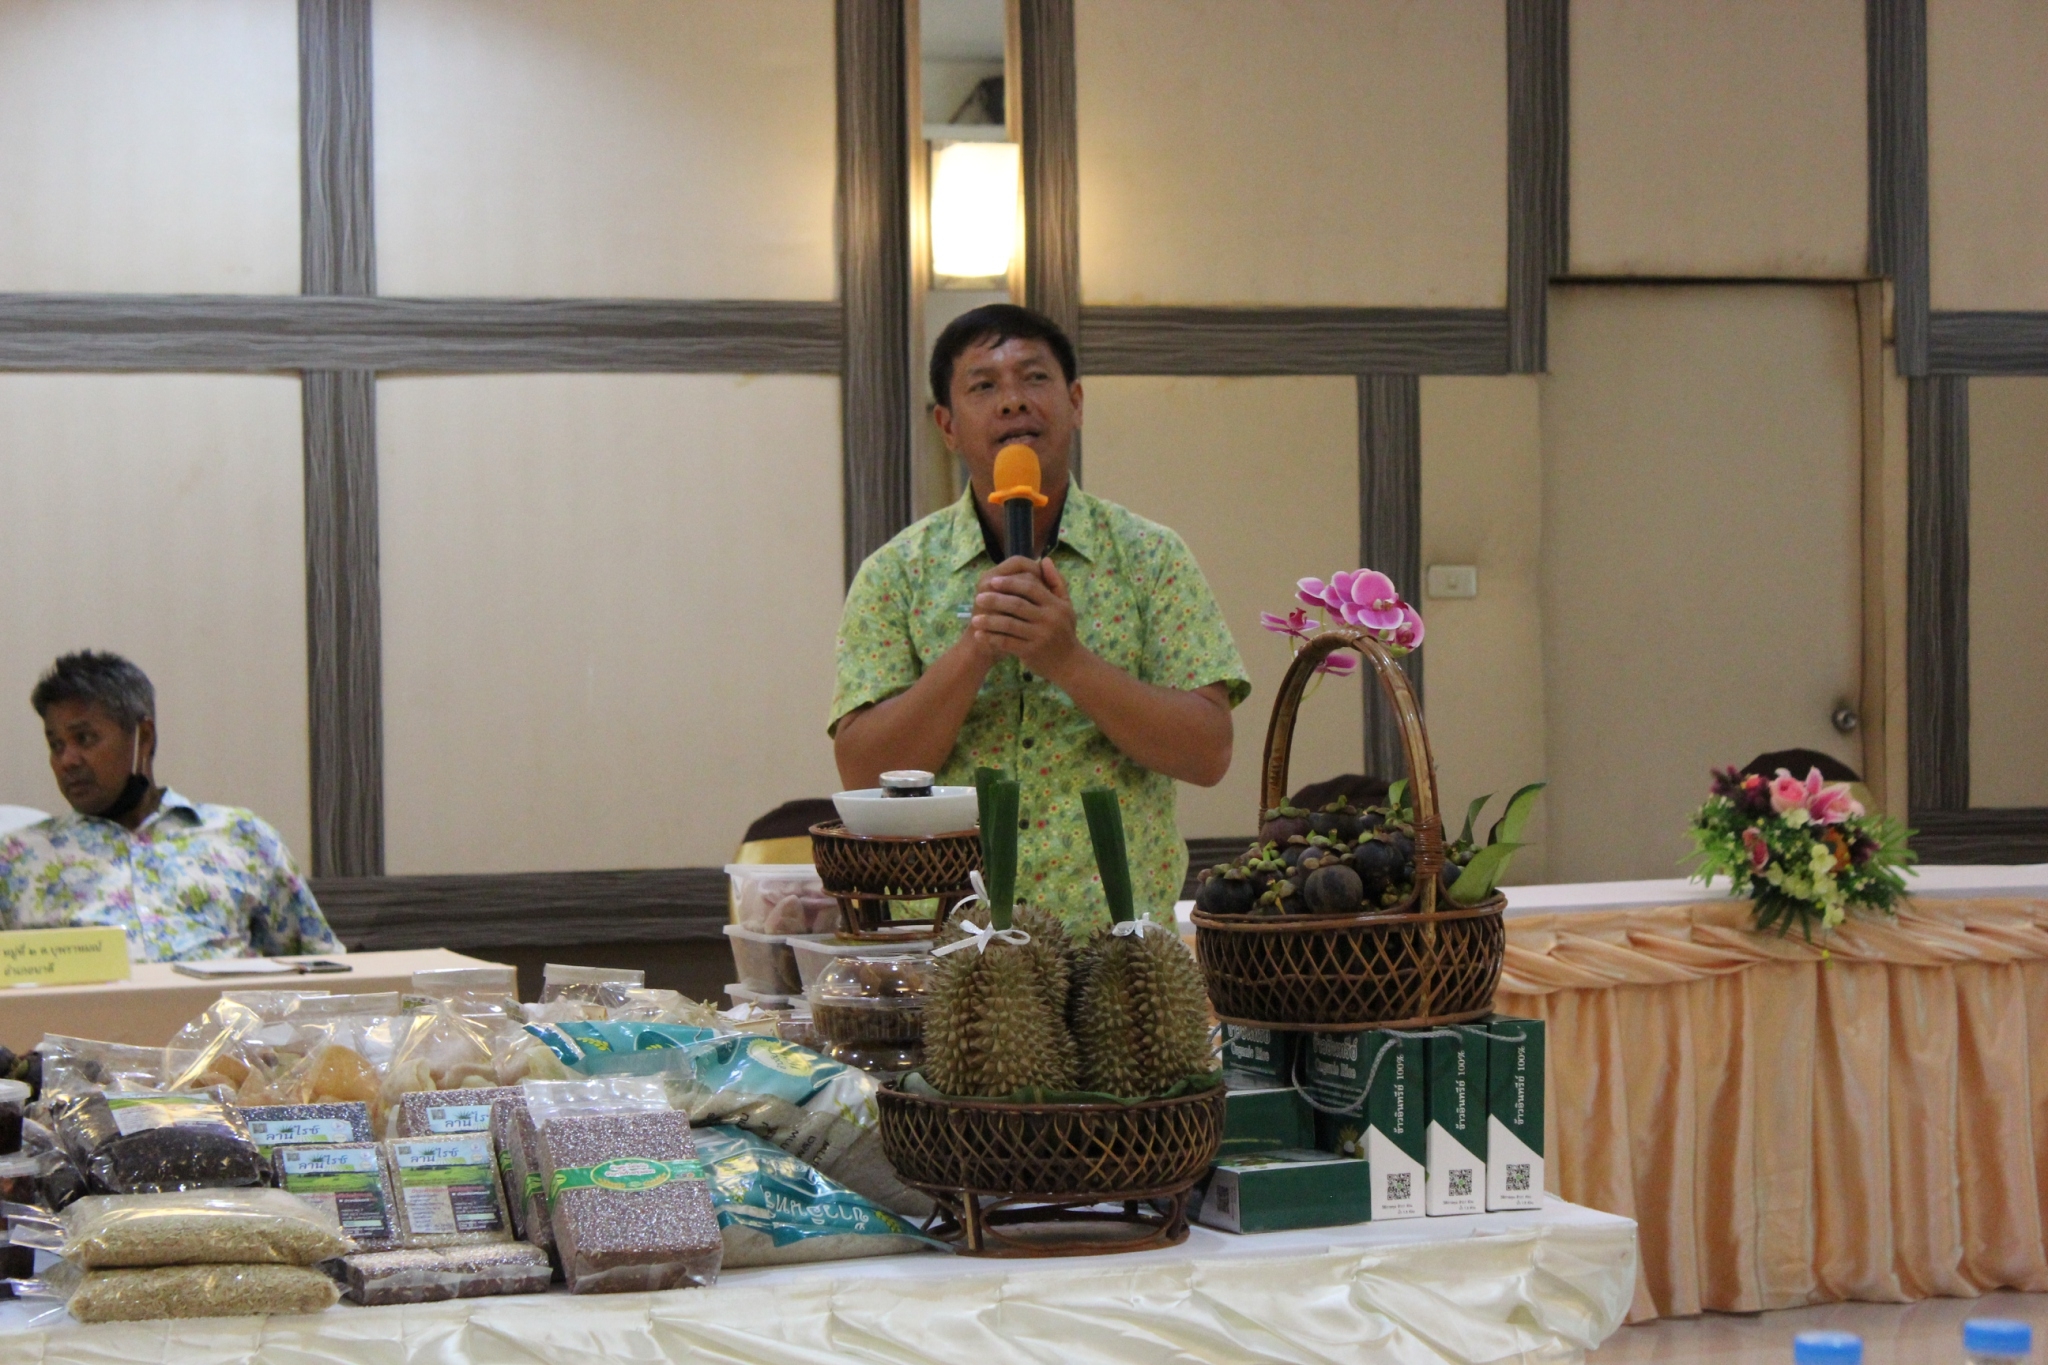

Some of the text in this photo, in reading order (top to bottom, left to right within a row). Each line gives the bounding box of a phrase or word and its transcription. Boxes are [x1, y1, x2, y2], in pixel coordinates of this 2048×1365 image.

[1394, 1054, 1405, 1134] ข้าวอินทรีย์ 100%
[1455, 1050, 1466, 1130] ข้าวอินทรีย์ 100%
[1514, 1046, 1526, 1125] ข้าวอินทรีย์ 100%
